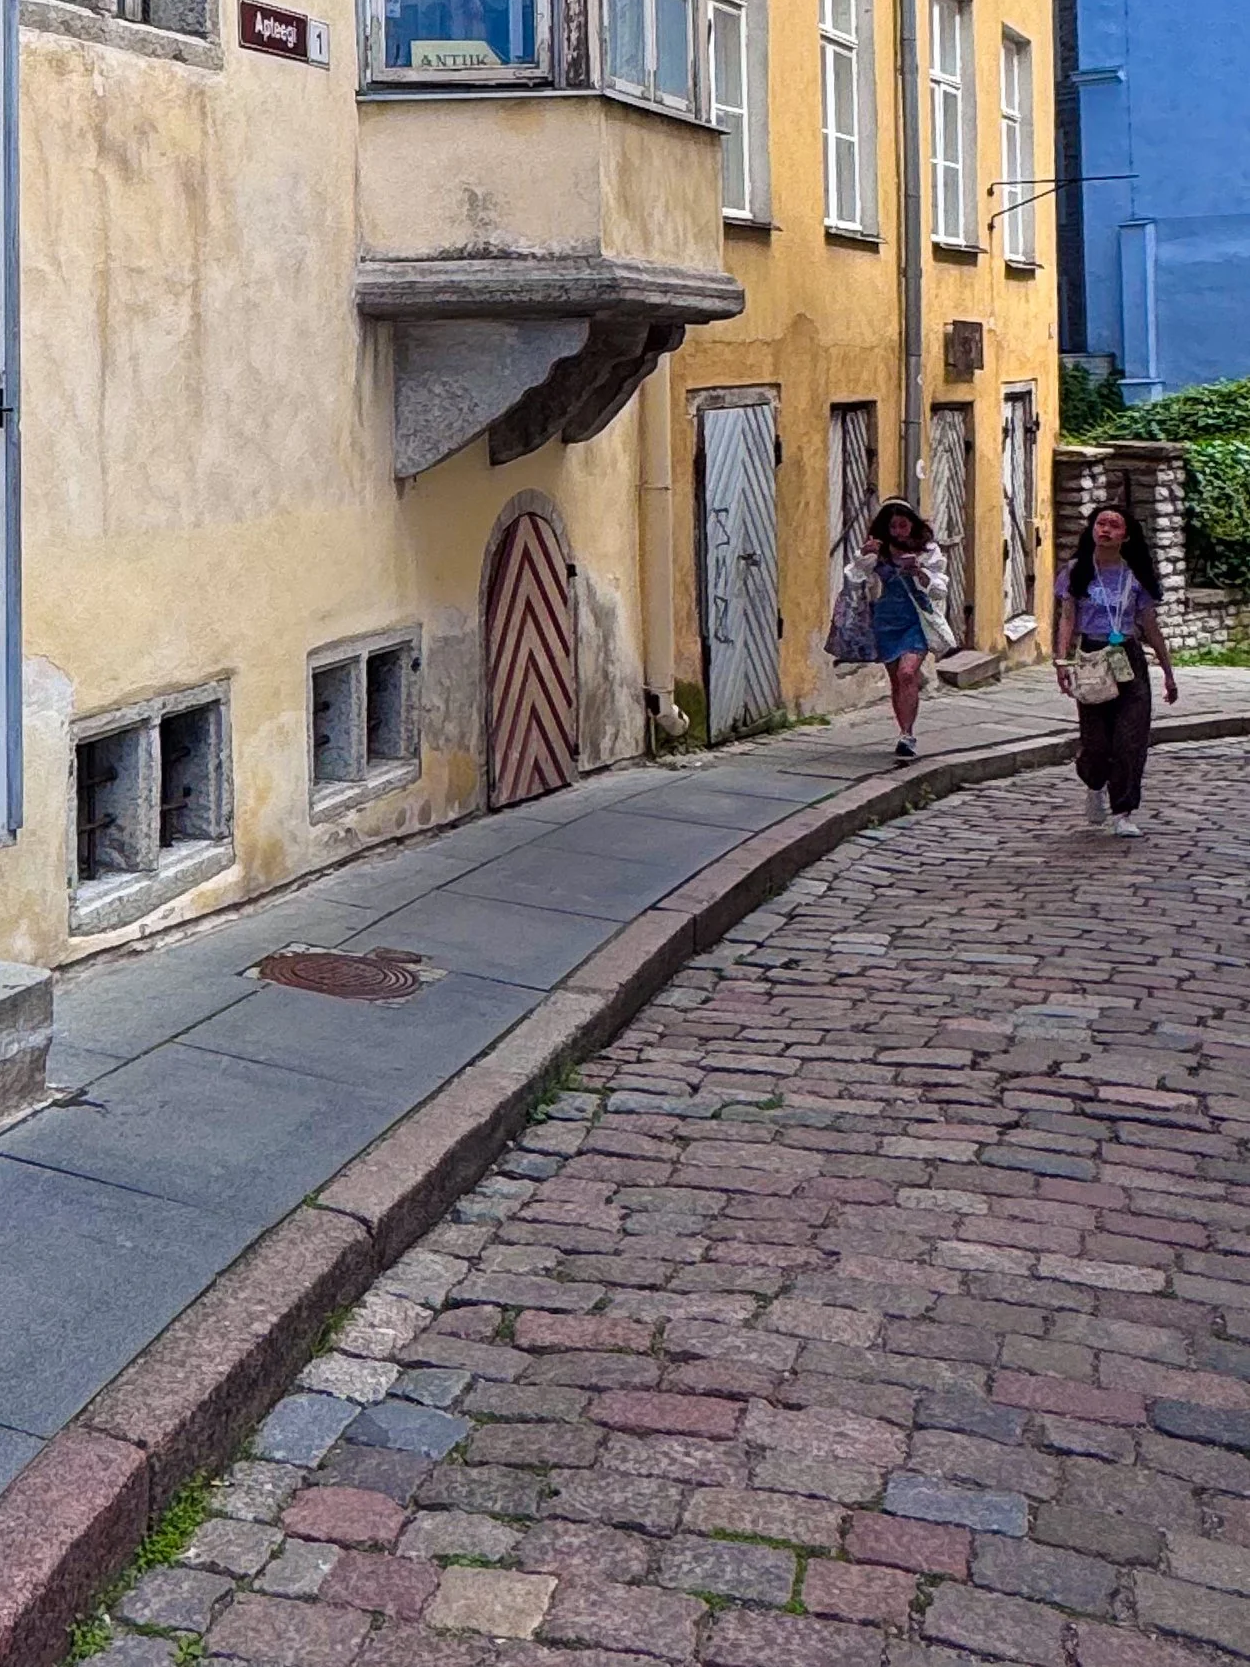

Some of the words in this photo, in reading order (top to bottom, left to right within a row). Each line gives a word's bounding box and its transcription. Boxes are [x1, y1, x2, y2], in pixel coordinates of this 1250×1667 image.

[254, 10, 298, 49] Apteegi
[315, 30, 322, 55] 1
[420, 53, 488, 66] ANTIIK
